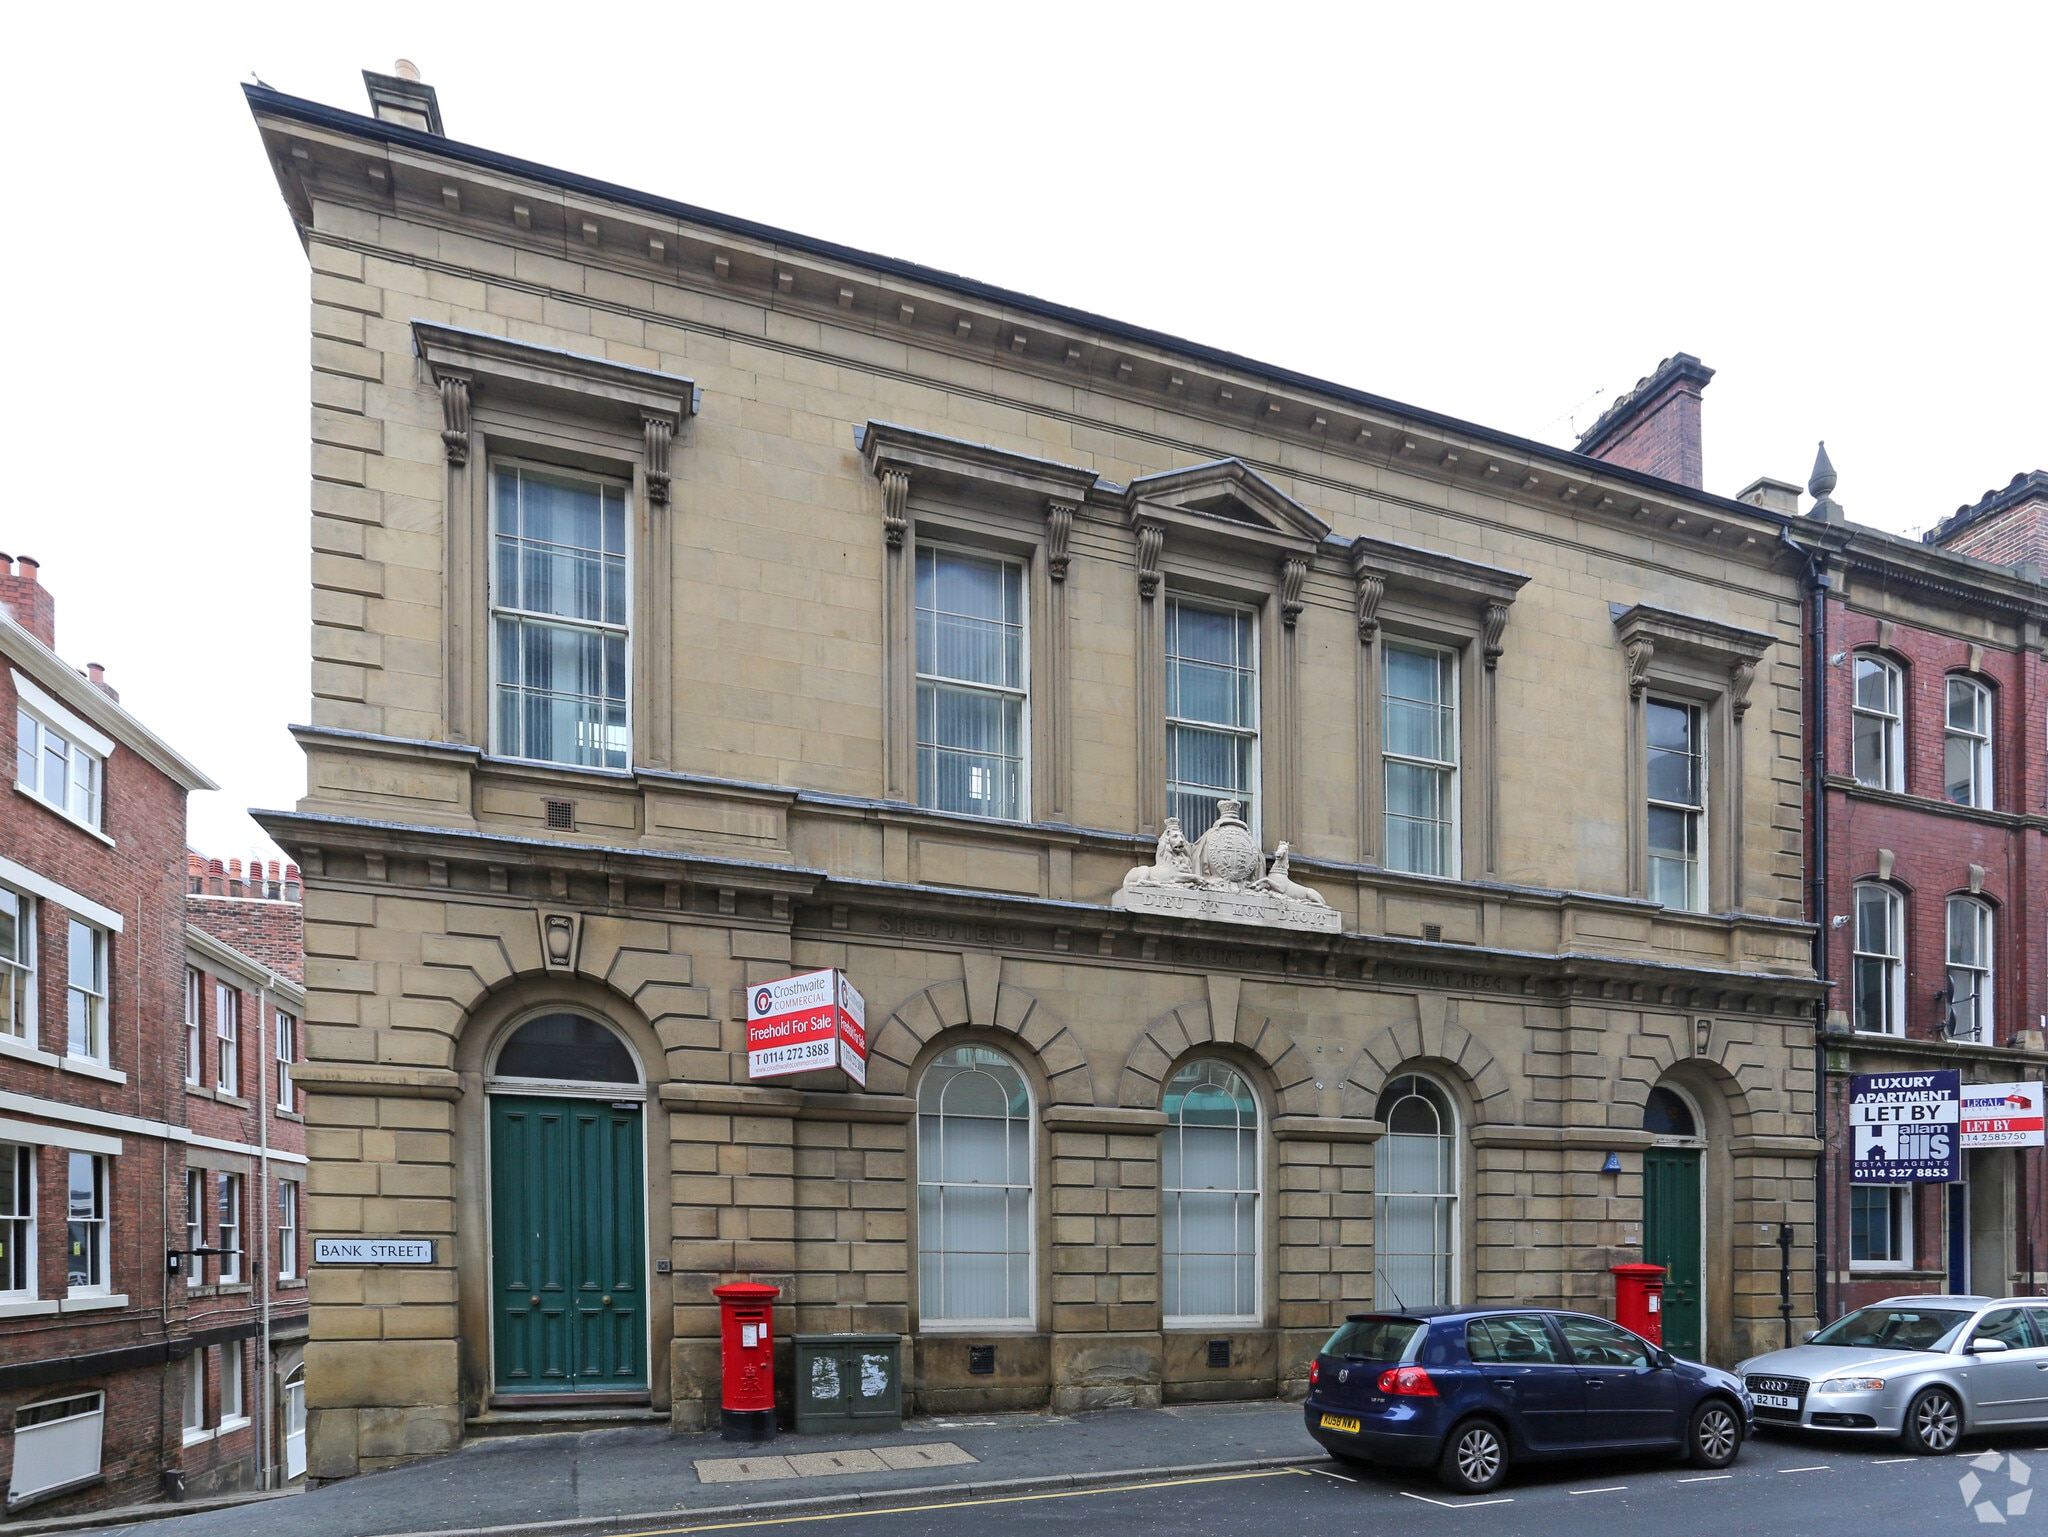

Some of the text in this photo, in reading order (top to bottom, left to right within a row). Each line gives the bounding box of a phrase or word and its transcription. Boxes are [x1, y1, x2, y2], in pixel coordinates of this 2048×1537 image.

[1142, 894, 1326, 926] DIEU ET MON DROIT
[880, 915, 1024, 945] SHEFFIELD
[1174, 943, 1264, 968] COUNTY
[774, 978, 825, 999] Crosthwaite
[774, 993, 825, 1011] COMMERCIAL
[750, 1014, 832, 1041] Freehold For Sale
[755, 1043, 829, 1065] T 0114 272 3888
[1870, 1076, 1935, 1090] LUXURY
[1854, 1090, 1951, 1104] APARTMENT
[1966, 1098, 2001, 1108] LEGAL
[1864, 1104, 1941, 1122] LET BY
[1966, 1120, 2011, 1132] LET BY
[1961, 1132, 2026, 1142] 114 2585750
[1855, 1168, 1949, 1178] 0114 327 8853
[321, 1245, 362, 1256] BANK
[370, 1245, 423, 1256] STREET
[1757, 1395, 1788, 1406] B2 TLB
